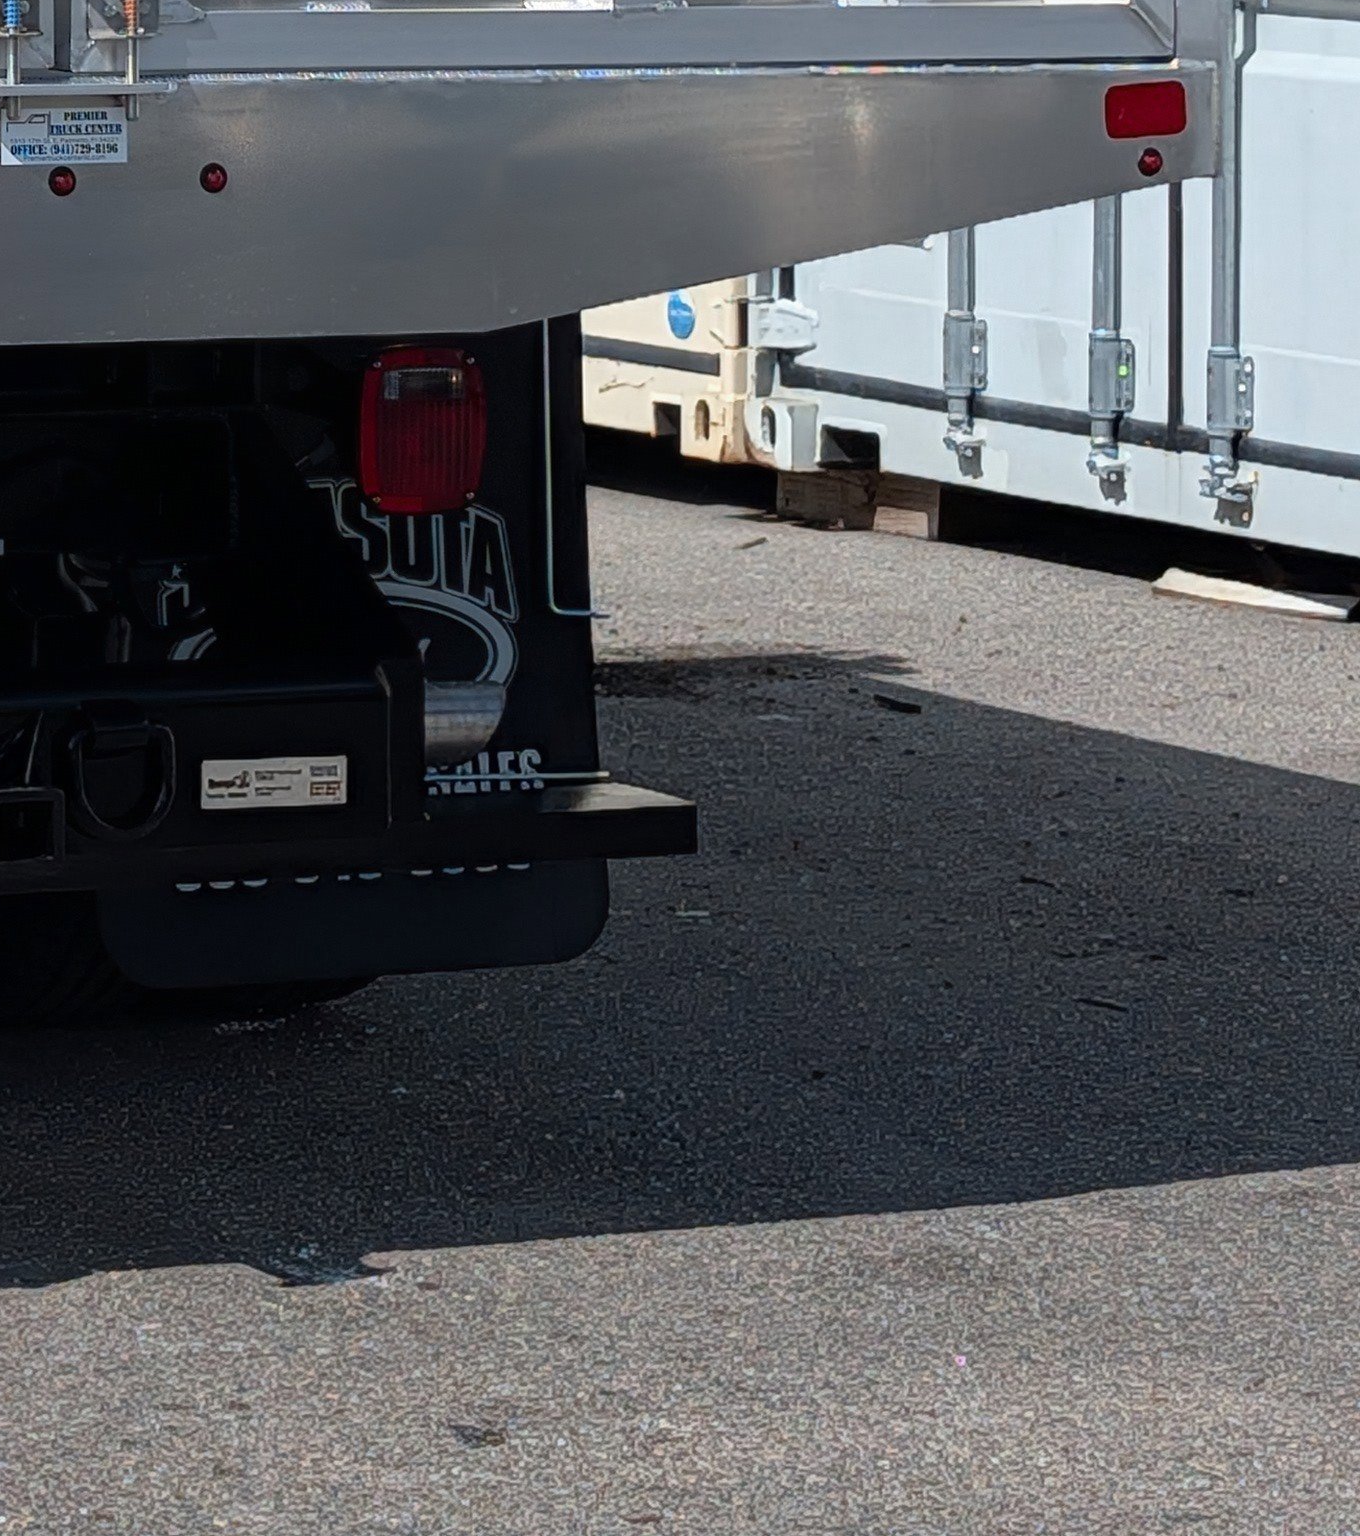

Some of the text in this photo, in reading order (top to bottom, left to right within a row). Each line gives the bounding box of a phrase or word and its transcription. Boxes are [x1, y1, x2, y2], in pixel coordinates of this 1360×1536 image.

[64, 111, 108, 121] PREMIER
[50, 123, 122, 135] TRUCK CENTER
[10, 144, 47, 155] OFFICE:
